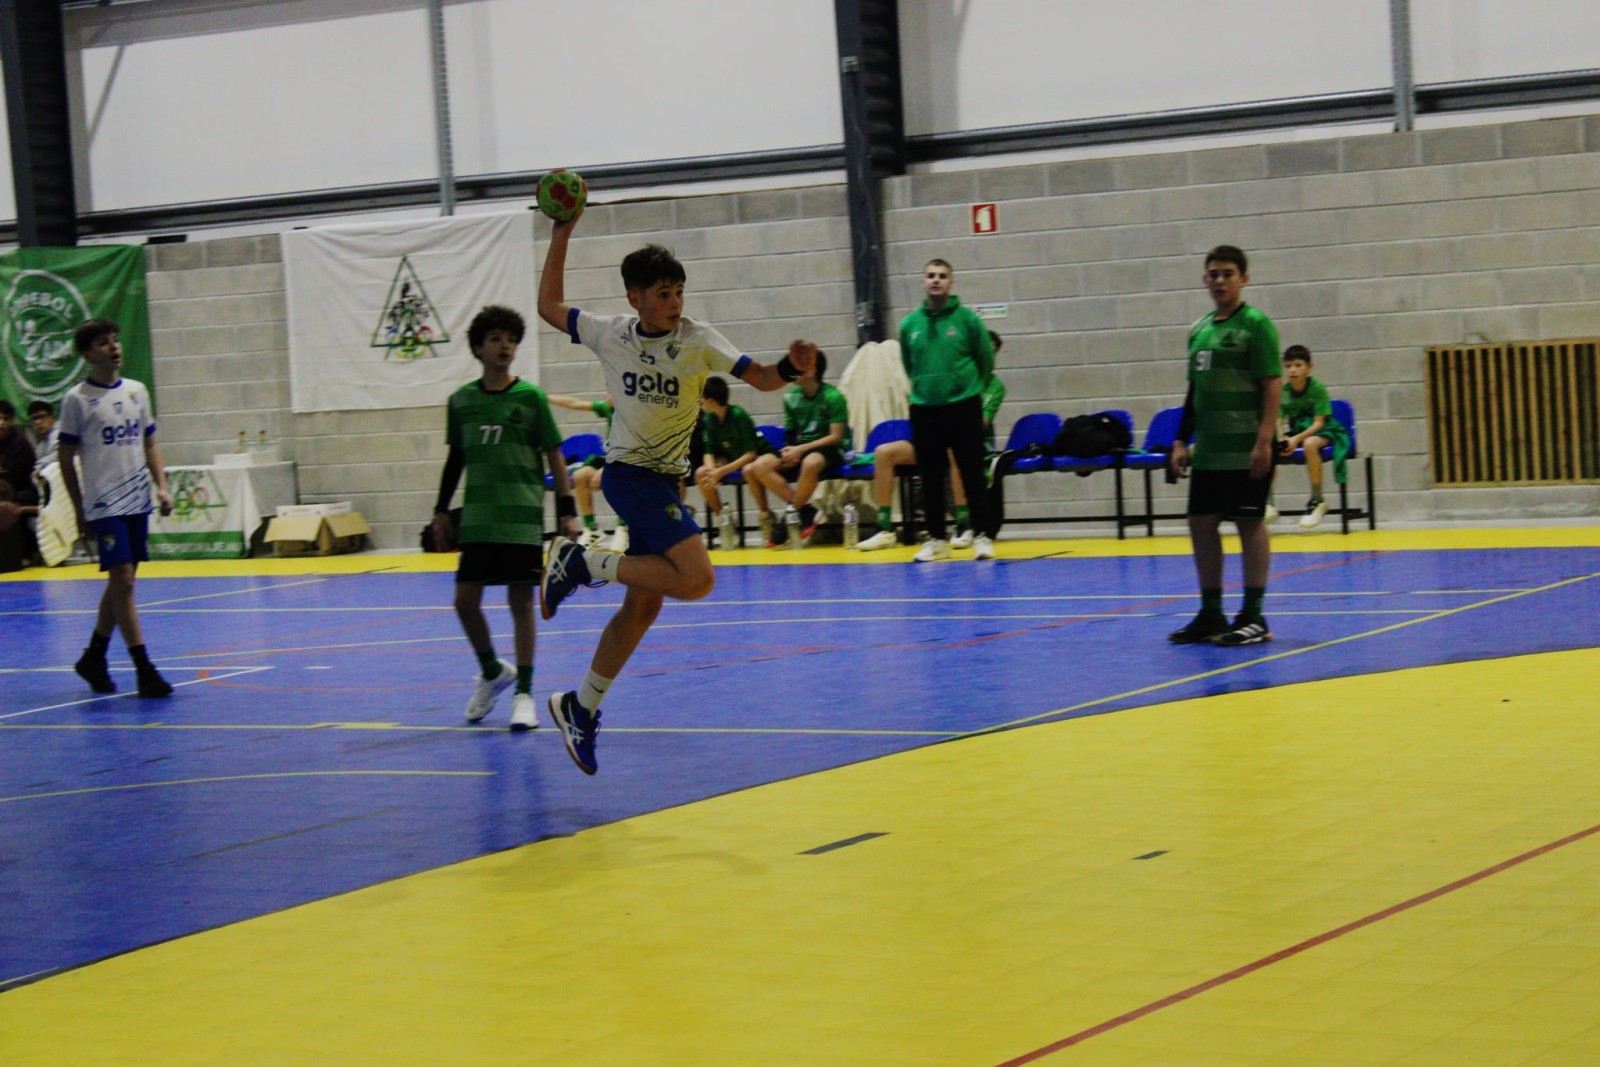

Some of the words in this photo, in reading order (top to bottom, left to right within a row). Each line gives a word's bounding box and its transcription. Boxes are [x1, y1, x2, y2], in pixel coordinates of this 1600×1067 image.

[622, 371, 680, 397] gold
[638, 393, 680, 409] energy
[479, 424, 503, 445] 77
